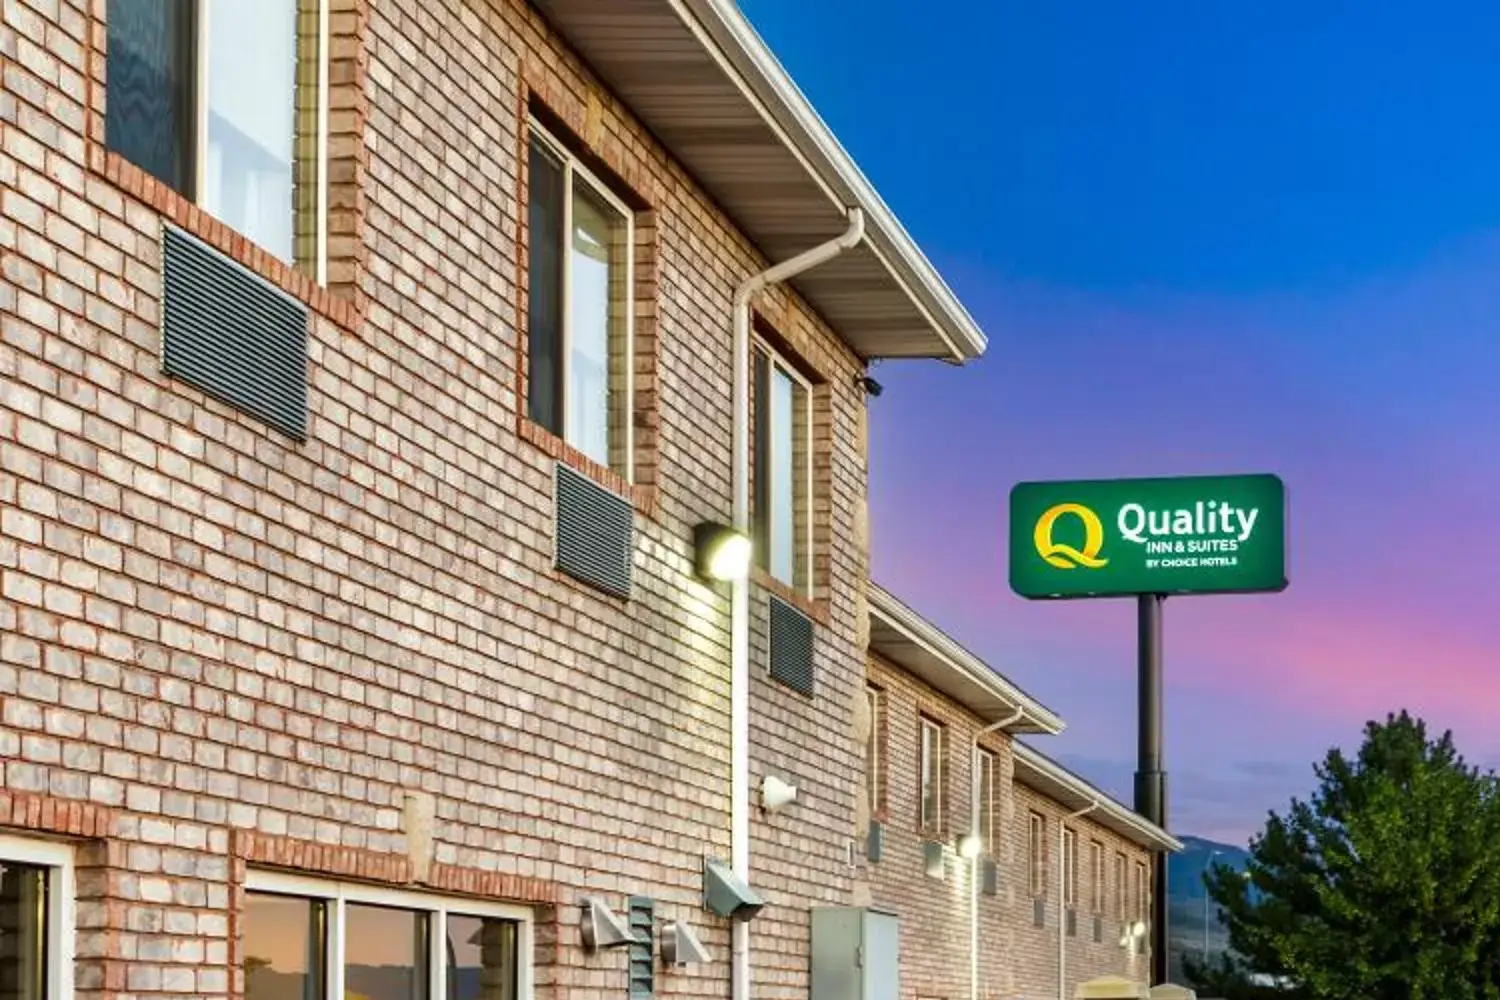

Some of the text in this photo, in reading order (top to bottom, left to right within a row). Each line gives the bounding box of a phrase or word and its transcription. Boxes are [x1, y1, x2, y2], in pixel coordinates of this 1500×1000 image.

[1034, 503, 1108, 568] Q
[1117, 501, 1258, 543] Quality
[1147, 539, 1238, 553] INN & SUITES
[1146, 557, 1238, 568] BY CHOICE HOTELS
